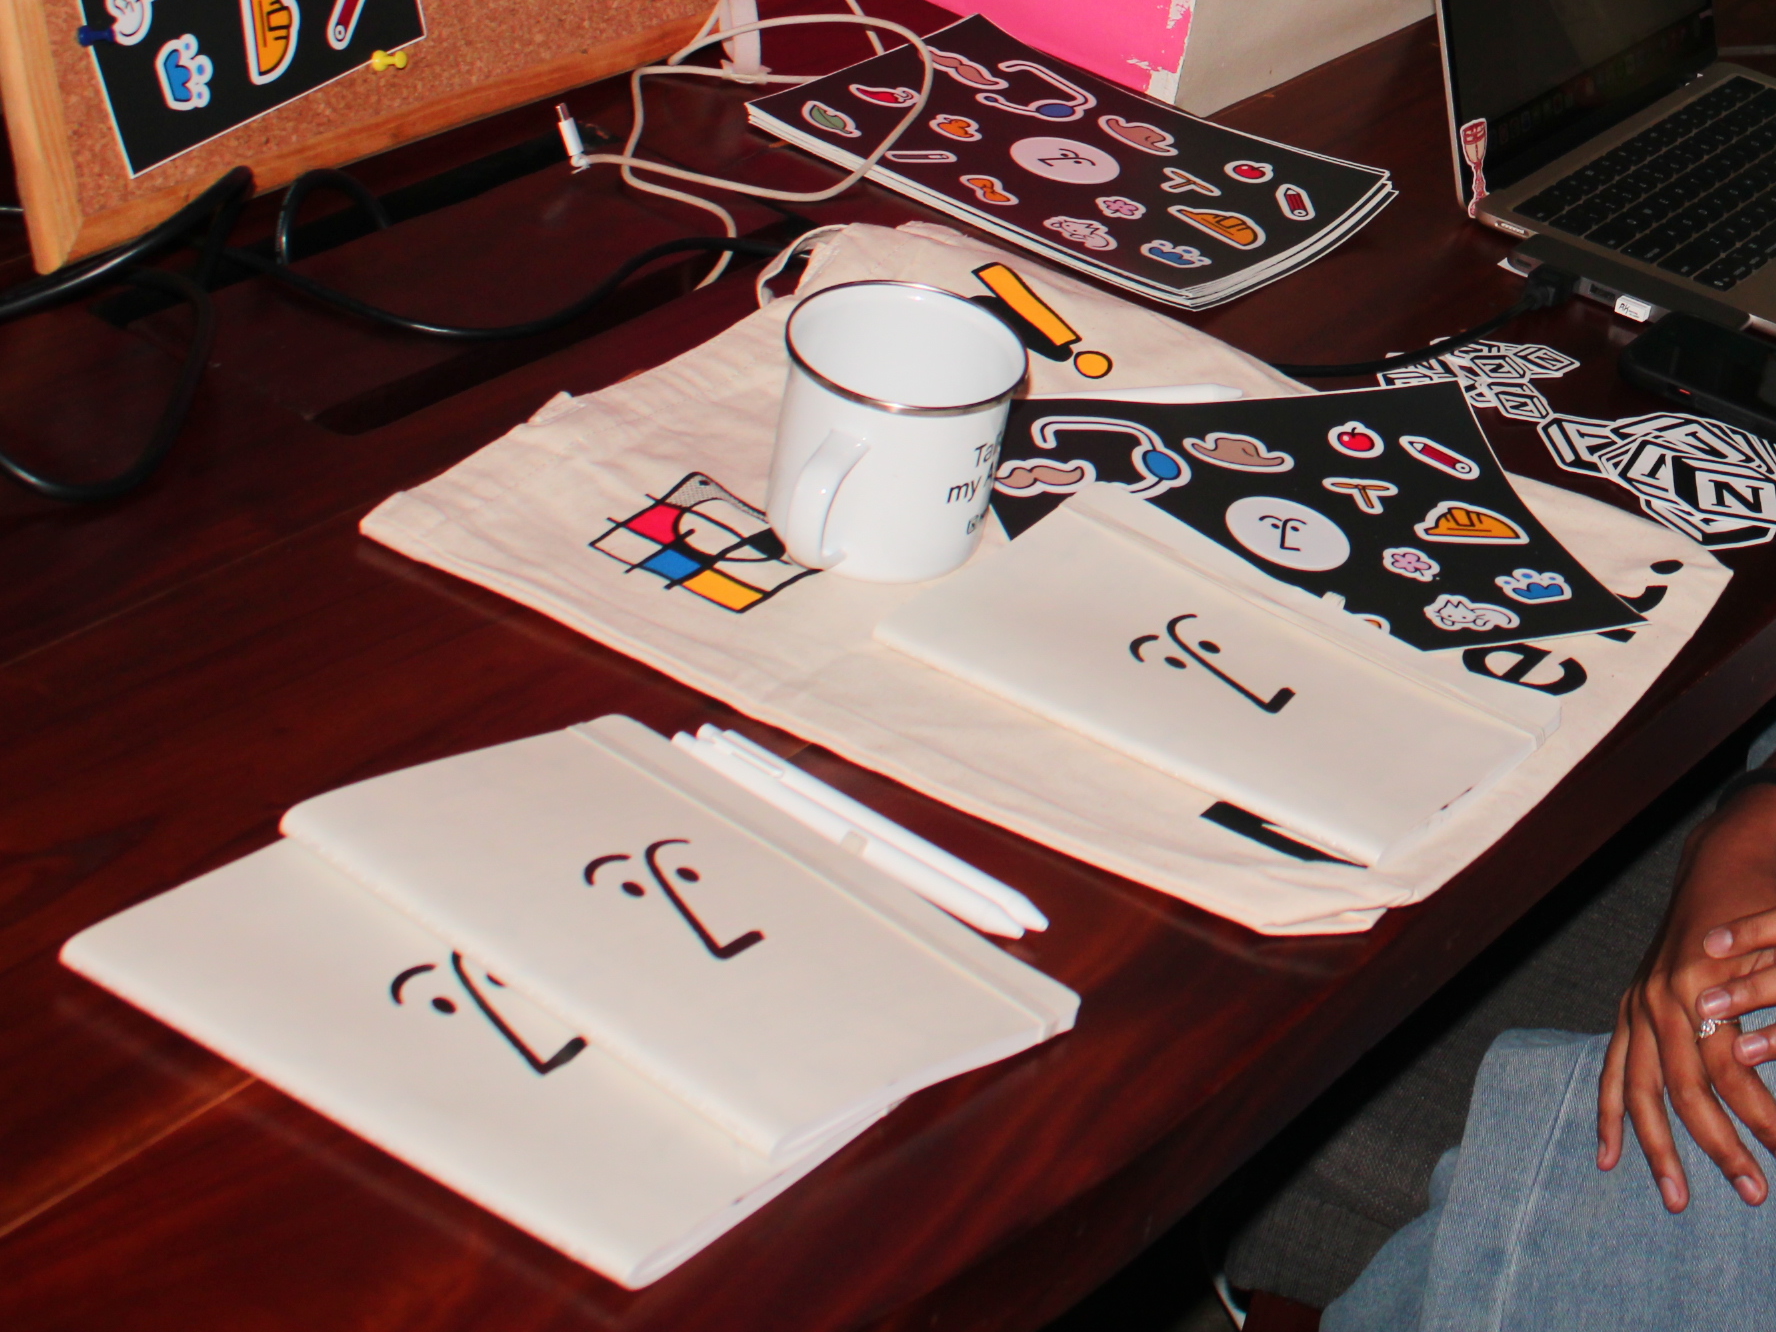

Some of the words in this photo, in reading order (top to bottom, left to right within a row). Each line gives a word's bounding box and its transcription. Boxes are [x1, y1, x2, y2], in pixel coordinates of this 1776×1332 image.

[1538, 352, 1562, 368] N
[946, 475, 982, 504] my
[1708, 479, 1764, 513] N
